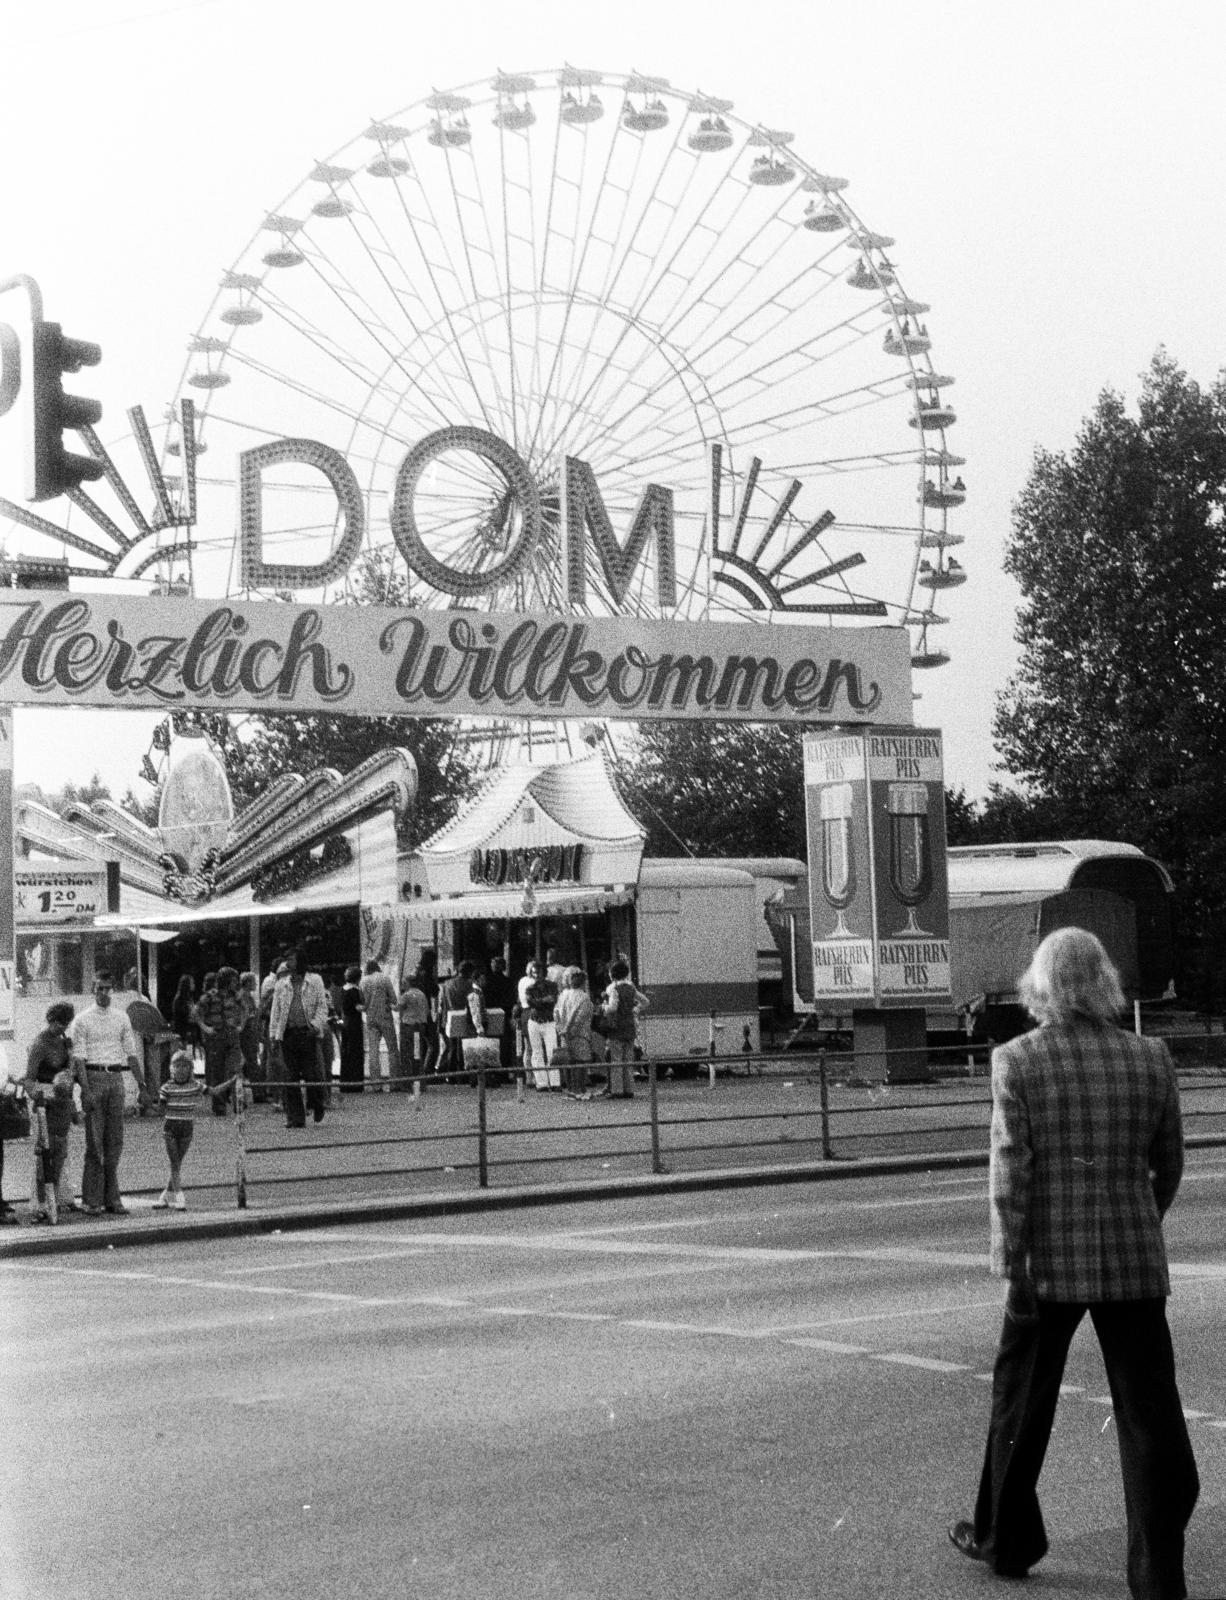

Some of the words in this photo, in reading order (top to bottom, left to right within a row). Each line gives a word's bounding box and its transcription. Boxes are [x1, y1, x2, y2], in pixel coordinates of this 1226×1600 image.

[237, 425, 676, 607] DOM
[0, 600, 355, 702] Herzlich
[379, 616, 882, 714] Willkommen
[869, 737, 940, 758] RATSHERRN
[896, 758, 920, 778] PILS
[814, 945, 870, 966] RATSHERRN
[880, 943, 949, 964] RATSHERRN
[833, 965, 853, 985] PILS
[903, 964, 929, 985] PILS
